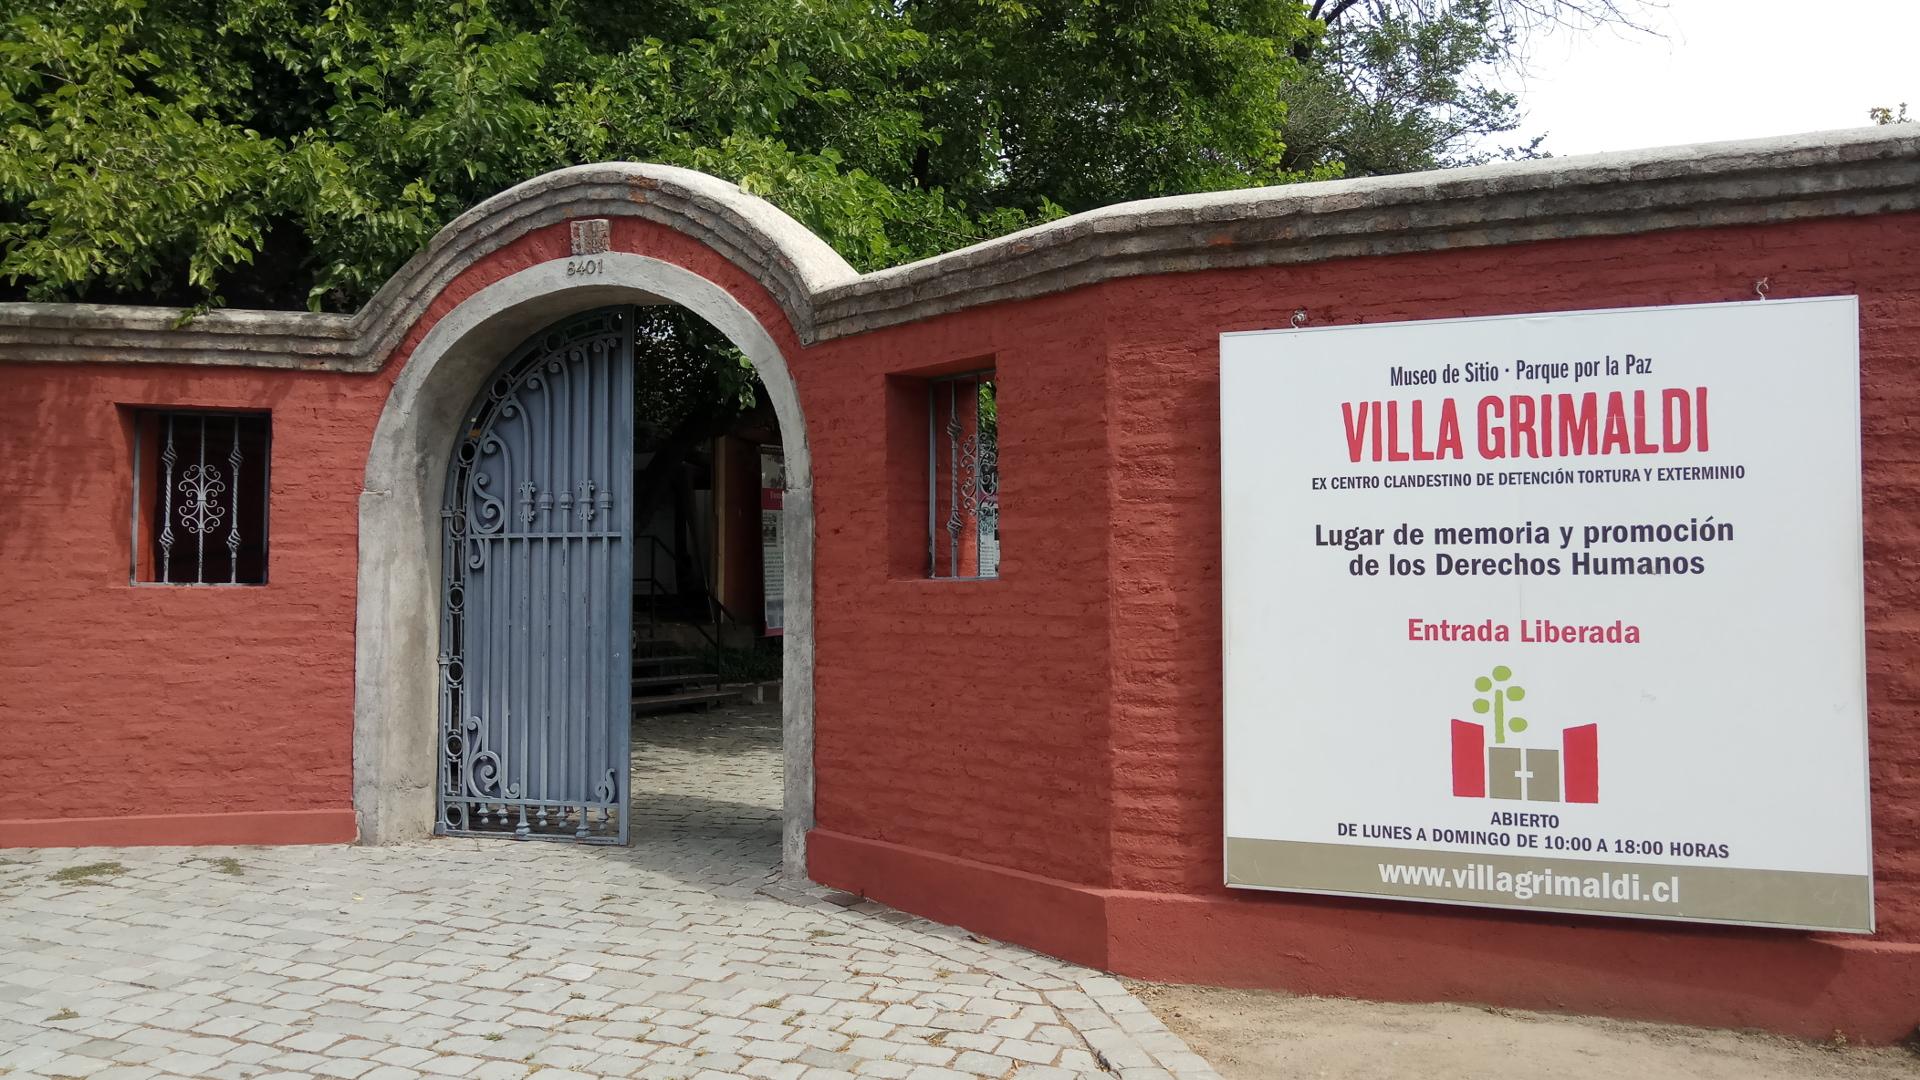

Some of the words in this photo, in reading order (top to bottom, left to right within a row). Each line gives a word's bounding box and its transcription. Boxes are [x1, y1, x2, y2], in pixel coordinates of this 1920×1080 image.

[1390, 366, 1437, 387] Museo
[1442, 363, 1460, 384] de
[1464, 361, 1499, 383] Sitio
[1516, 359, 1569, 385] Parque
[1574, 360, 1601, 383] por
[1605, 355, 1619, 376] la
[1625, 353, 1653, 375] Paz
[1341, 397, 1464, 463] VILLA
[1477, 386, 1709, 461] GRIMALDI
[1312, 477, 1328, 491] EX
[1330, 475, 1380, 490] CENTRO
[1383, 473, 1472, 489] CLANDESTINO
[1476, 472, 1495, 486] DE
[1498, 467, 1574, 486] DETENCIÓN
[1577, 468, 1641, 484] TORTURA
[1643, 468, 1653, 482] Y
[1657, 464, 1746, 482] EXTERMINIO
[1315, 524, 1385, 552] Lugar
[1393, 522, 1425, 546] de
[1434, 520, 1550, 546] memoria
[1559, 526, 1574, 550] y
[1583, 515, 1734, 549] promoción
[1349, 553, 1380, 576] de
[1389, 553, 1426, 576] los
[1435, 552, 1561, 576] Derechos
[1571, 552, 1705, 576] Humanos
[1408, 618, 1510, 642] Entrada
[1520, 619, 1640, 644] Liberada
[1490, 811, 1560, 829] ABIERTO
[1337, 822, 1358, 837] DE
[1362, 823, 1413, 841] LUNES
[1415, 827, 1427, 842] A
[1432, 828, 1511, 847] DOMINGO
[1516, 833, 1539, 849] DE
[1544, 835, 1592, 852] 10:00
[1596, 838, 1609, 853] A
[1614, 839, 1664, 856] 18:00
[1669, 841, 1730, 859] HORAS
[1377, 863, 1679, 903] www.villagrimaldi.cl
